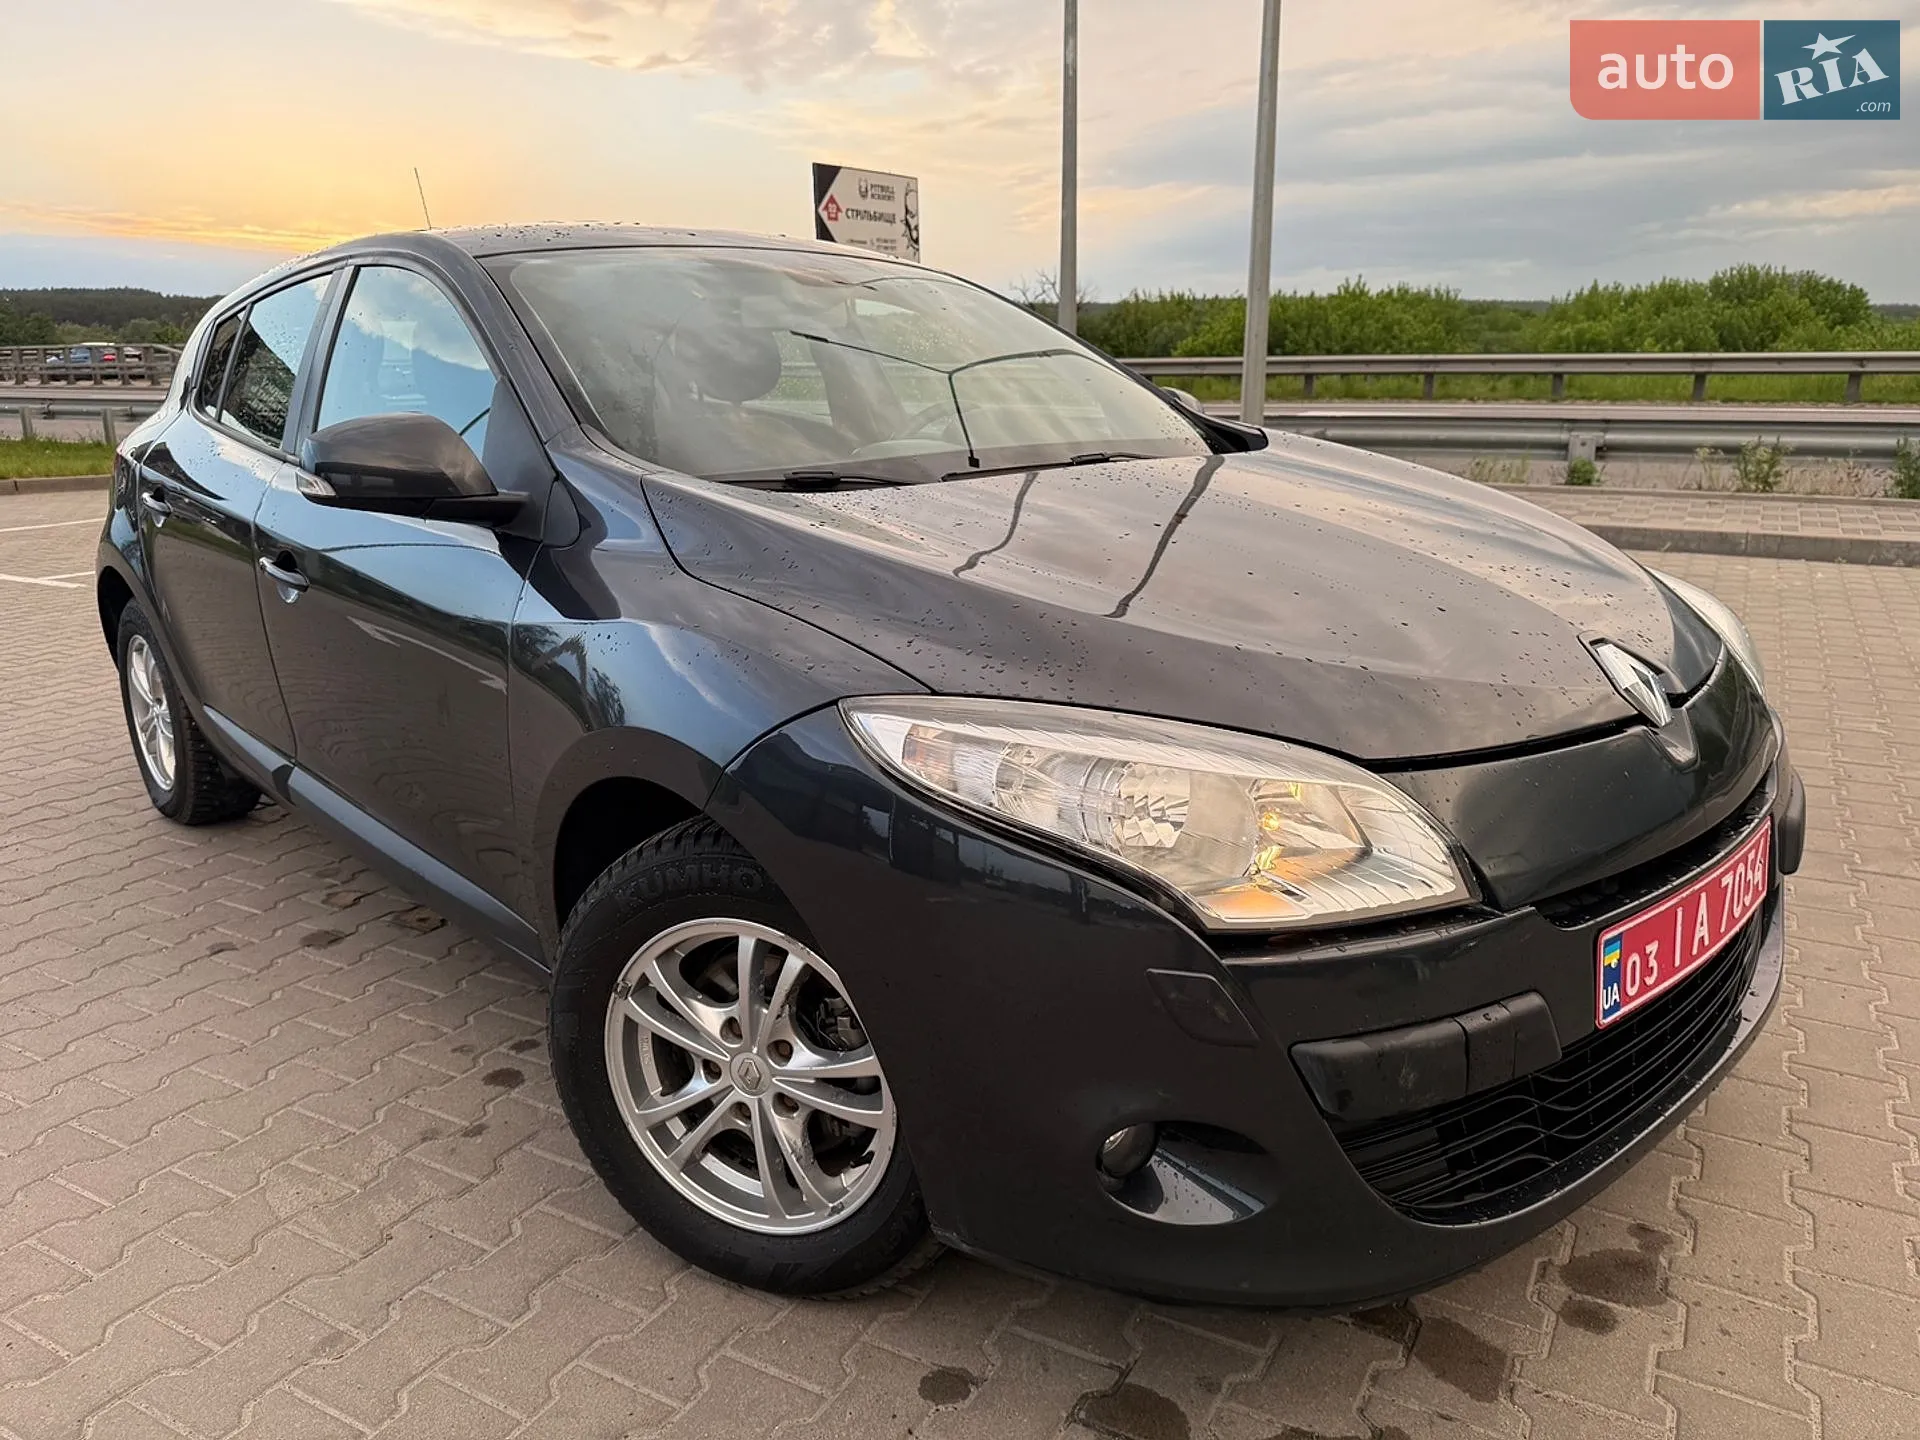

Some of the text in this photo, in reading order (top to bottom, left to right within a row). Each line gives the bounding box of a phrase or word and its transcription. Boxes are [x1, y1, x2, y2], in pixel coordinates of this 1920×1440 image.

[845, 208, 896, 225] СТРІЛЬБИЩЕ
[1626, 838, 1765, 996] 03 IA 7054
[1603, 982, 1620, 1010] UA
